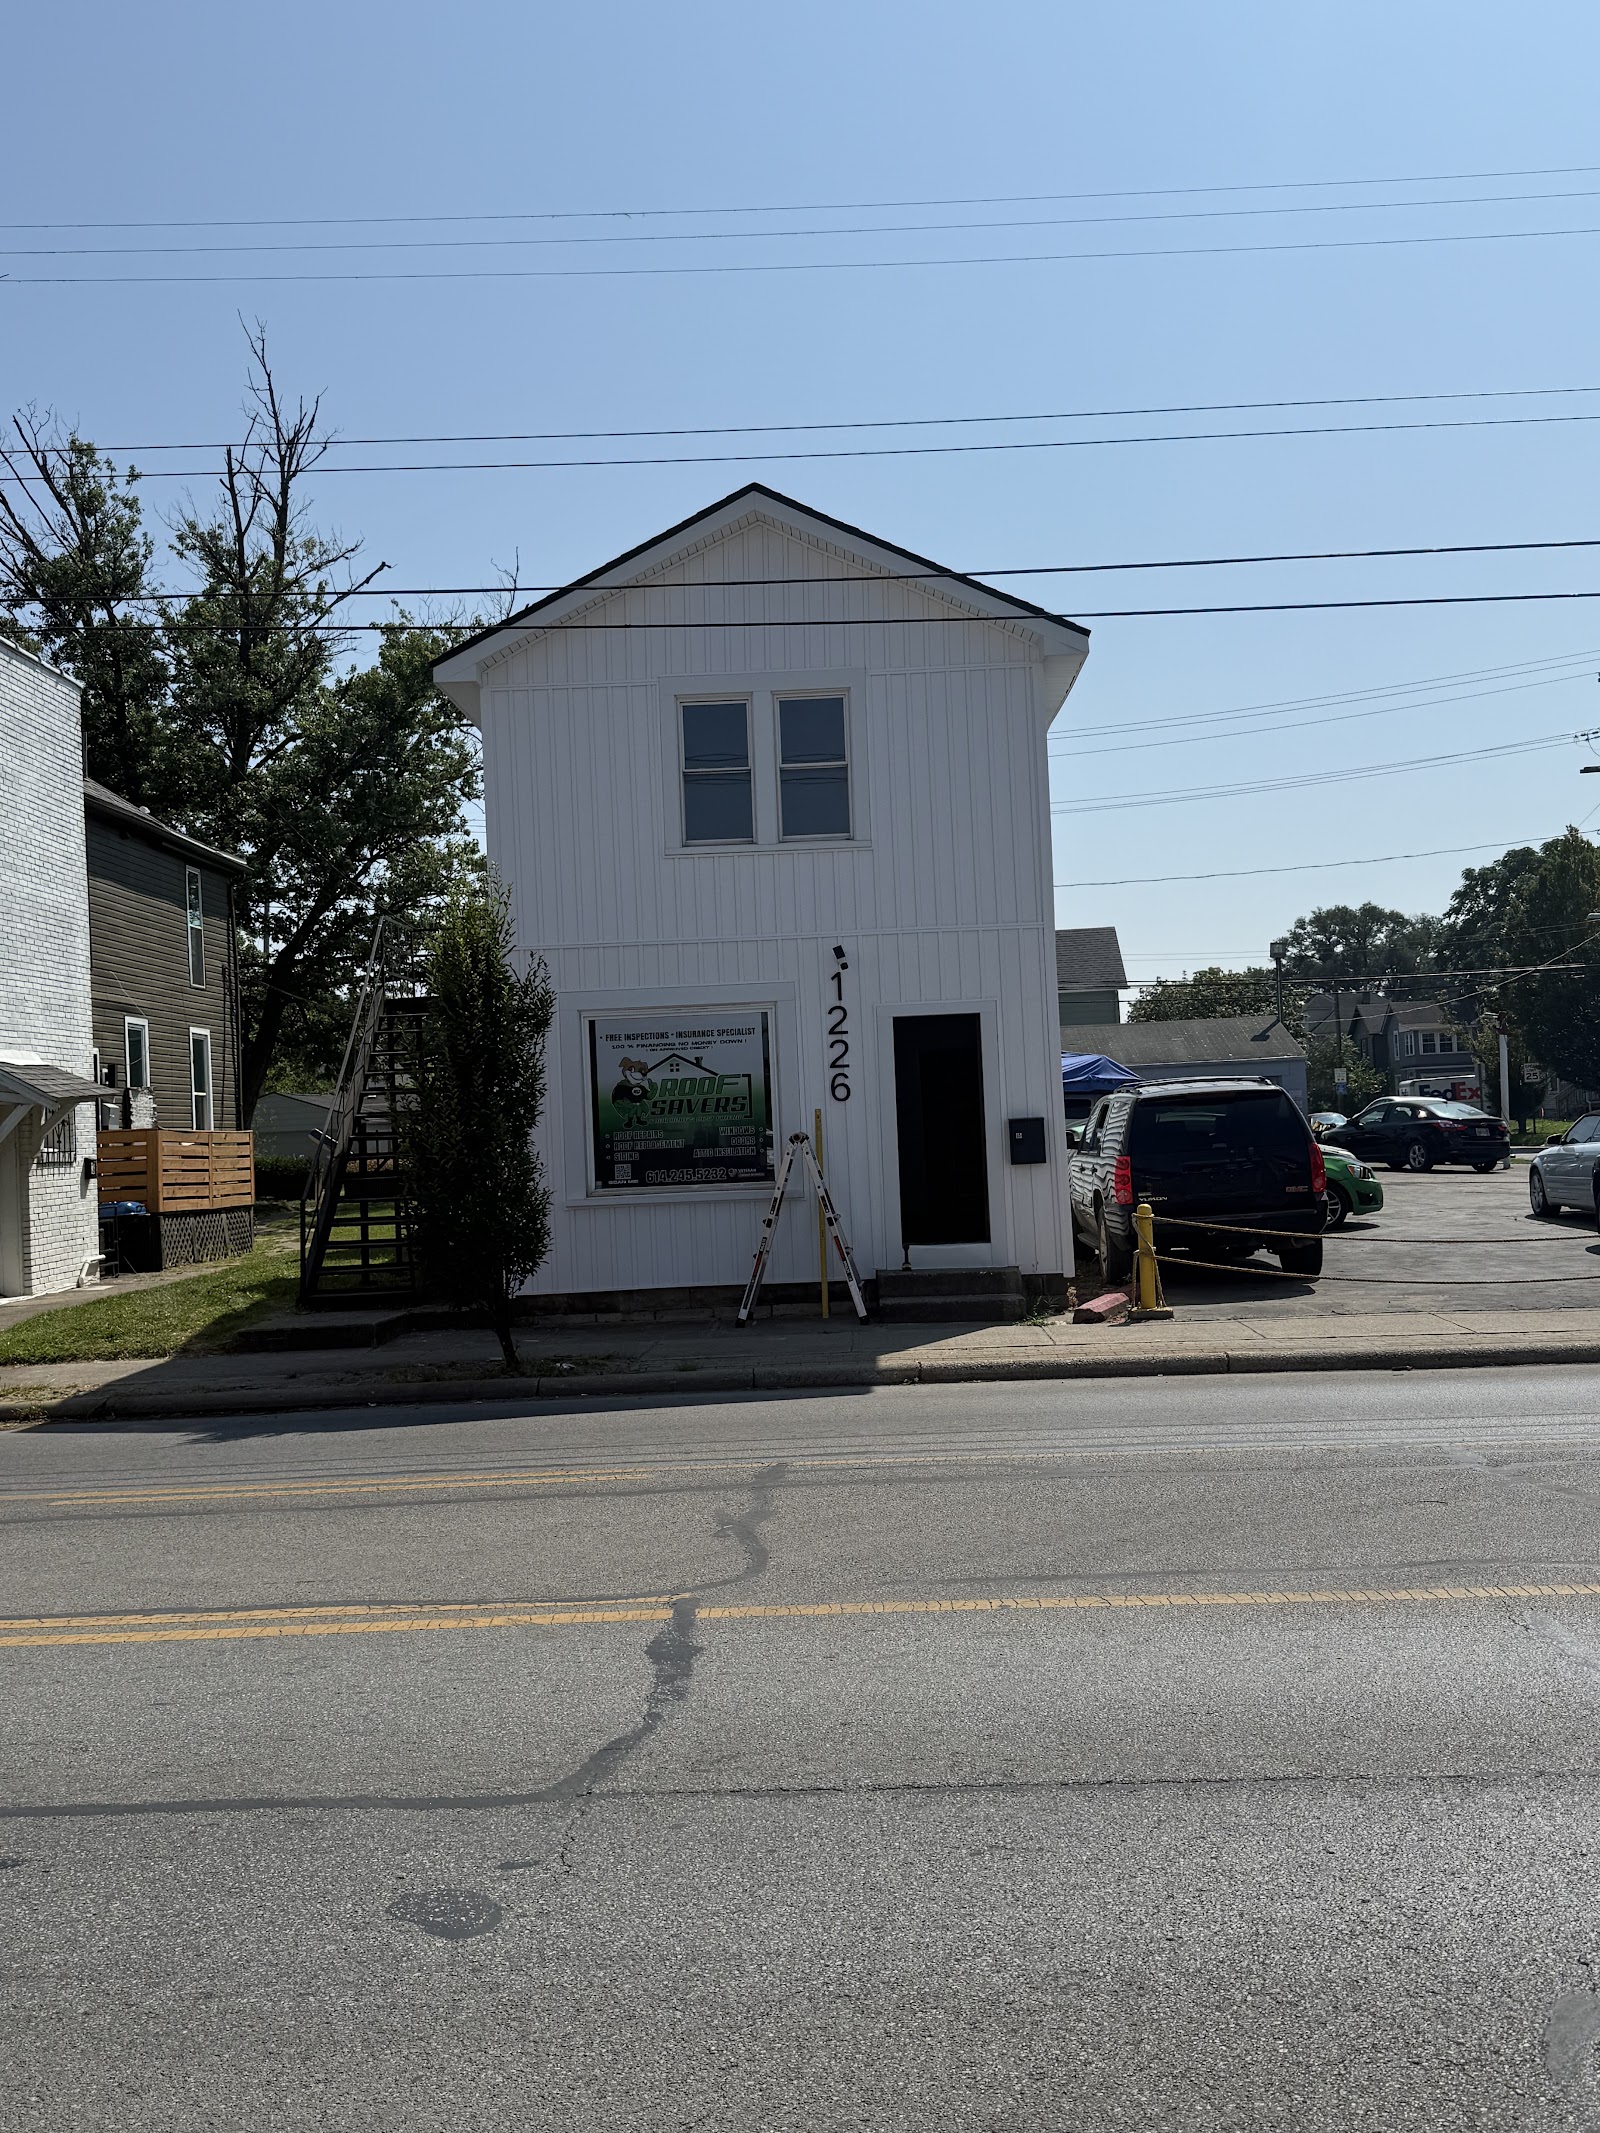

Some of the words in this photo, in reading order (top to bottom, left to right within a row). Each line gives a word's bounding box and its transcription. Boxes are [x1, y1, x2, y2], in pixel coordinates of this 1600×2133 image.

[605, 1032, 623, 1042] FREE
[624, 1031, 670, 1042] INSPECTIONS
[675, 1029, 716, 1040] INSURANCE
[716, 1027, 756, 1038] SPECIALIST
[828, 971, 851, 1102] 1226
[1526, 1072, 1538, 1080] 25
[659, 1073, 742, 1097] ROOF
[650, 1096, 748, 1116] SAVERS
[613, 1131, 633, 1141] ROOF
[634, 1130, 664, 1140] REPAIRS
[719, 1126, 755, 1136] WINDOWS
[613, 1140, 634, 1151] ROOF
[634, 1138, 685, 1150] REPLACEMENT
[731, 1136, 756, 1146] DOORS
[613, 1152, 640, 1162] SIDING
[714, 1147, 756, 1158] INSULATION
[646, 1167, 727, 1184] 614.245.5232
